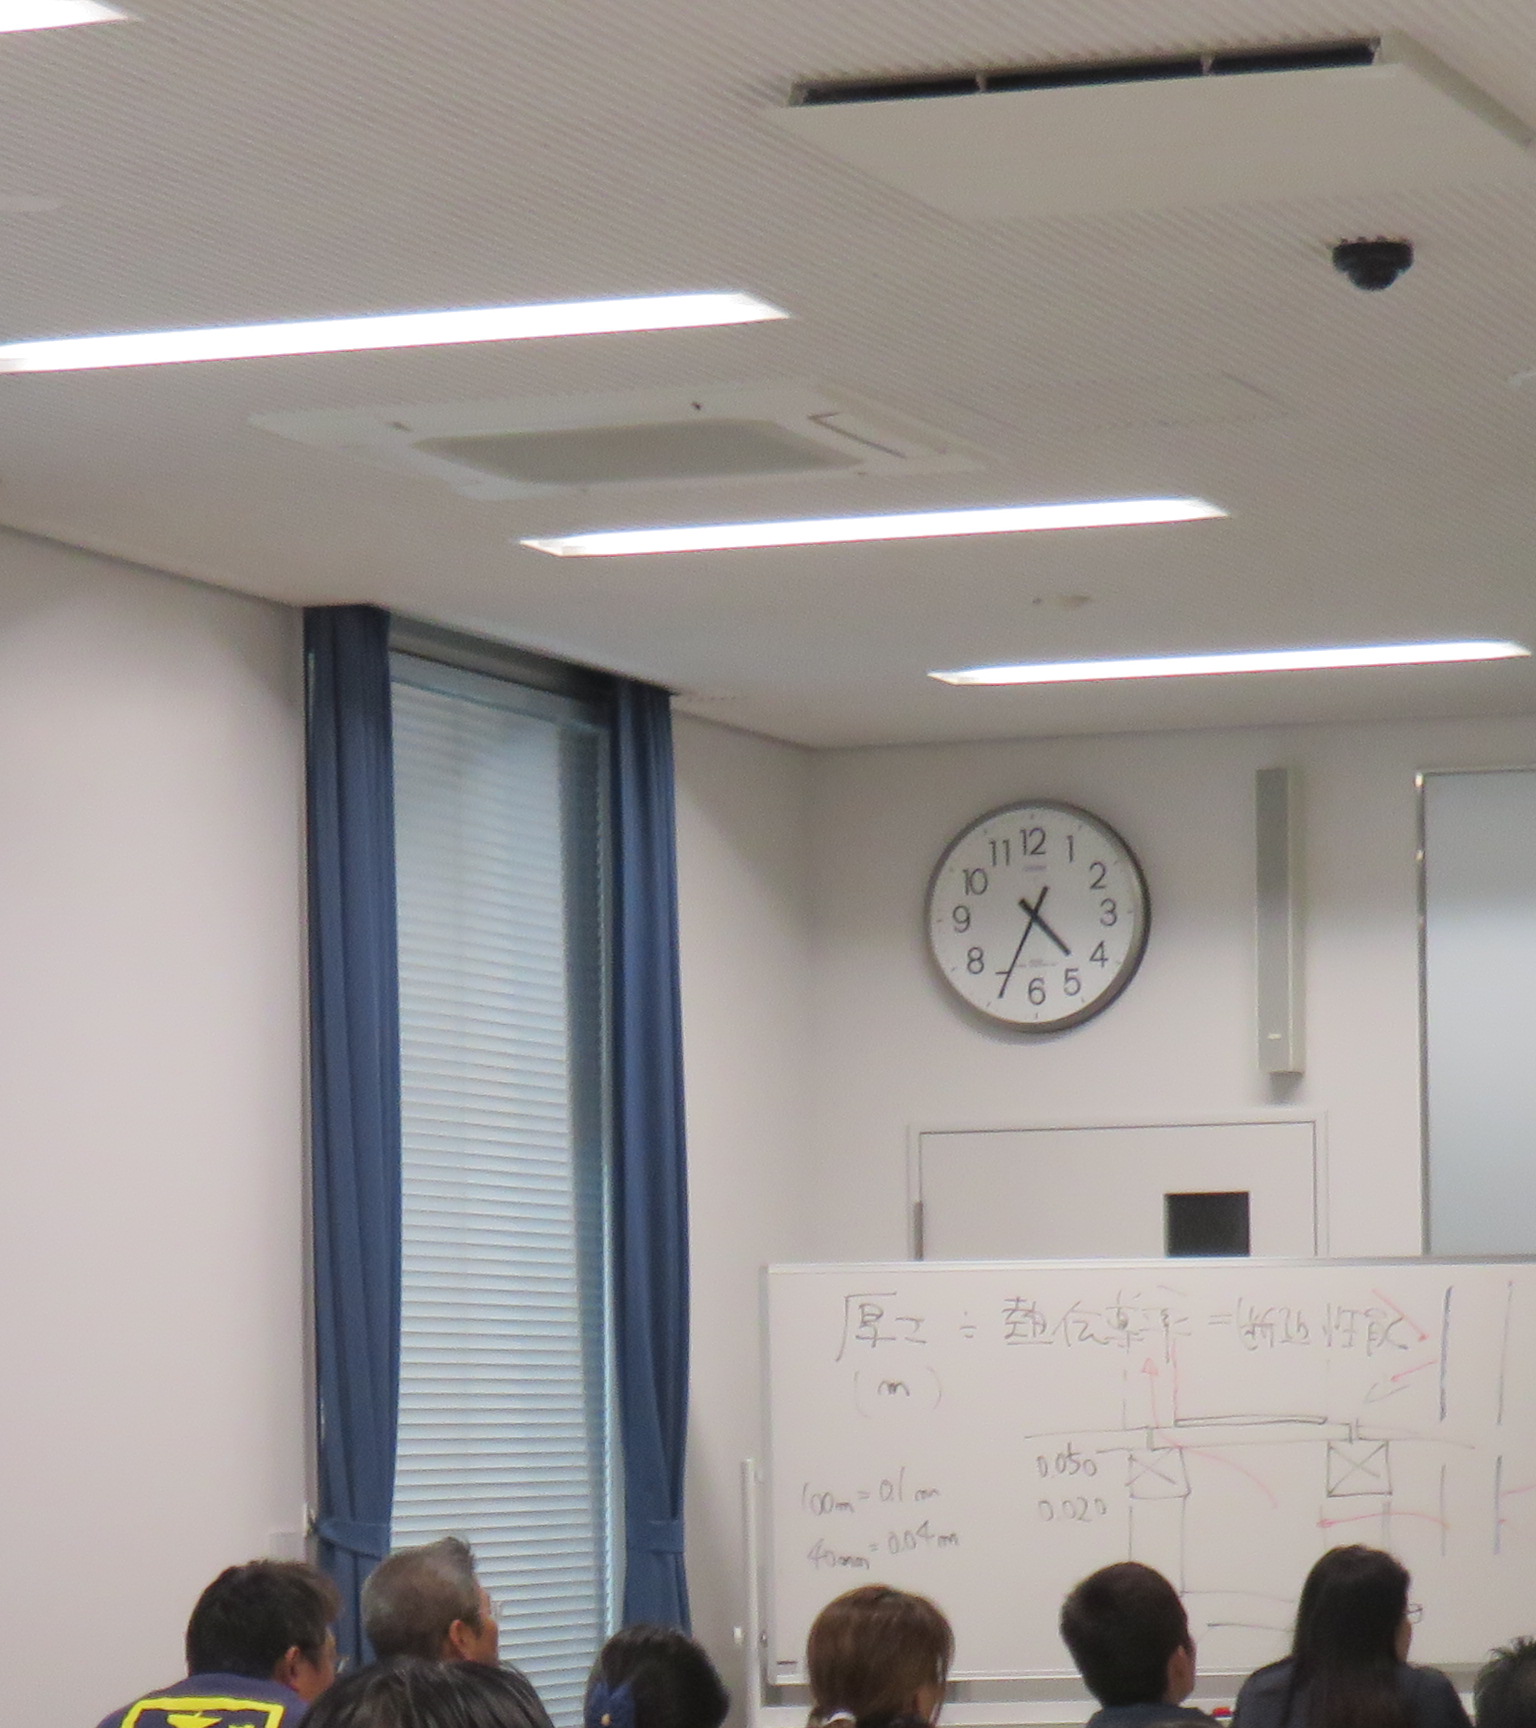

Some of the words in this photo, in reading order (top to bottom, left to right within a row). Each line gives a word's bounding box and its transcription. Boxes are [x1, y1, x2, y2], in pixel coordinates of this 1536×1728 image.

[989, 839, 1010, 867] 11
[1020, 827, 1046, 856] 12
[1067, 835, 1074, 862] 1
[963, 868, 989, 896] 10
[1089, 862, 1106, 890] 2
[952, 905, 971, 933] 9
[1100, 898, 1117, 927] 3
[967, 947, 985, 975] 8
[1089, 941, 1109, 968] 4
[1028, 977, 1046, 1006] 6
[1064, 968, 1081, 996] 5
